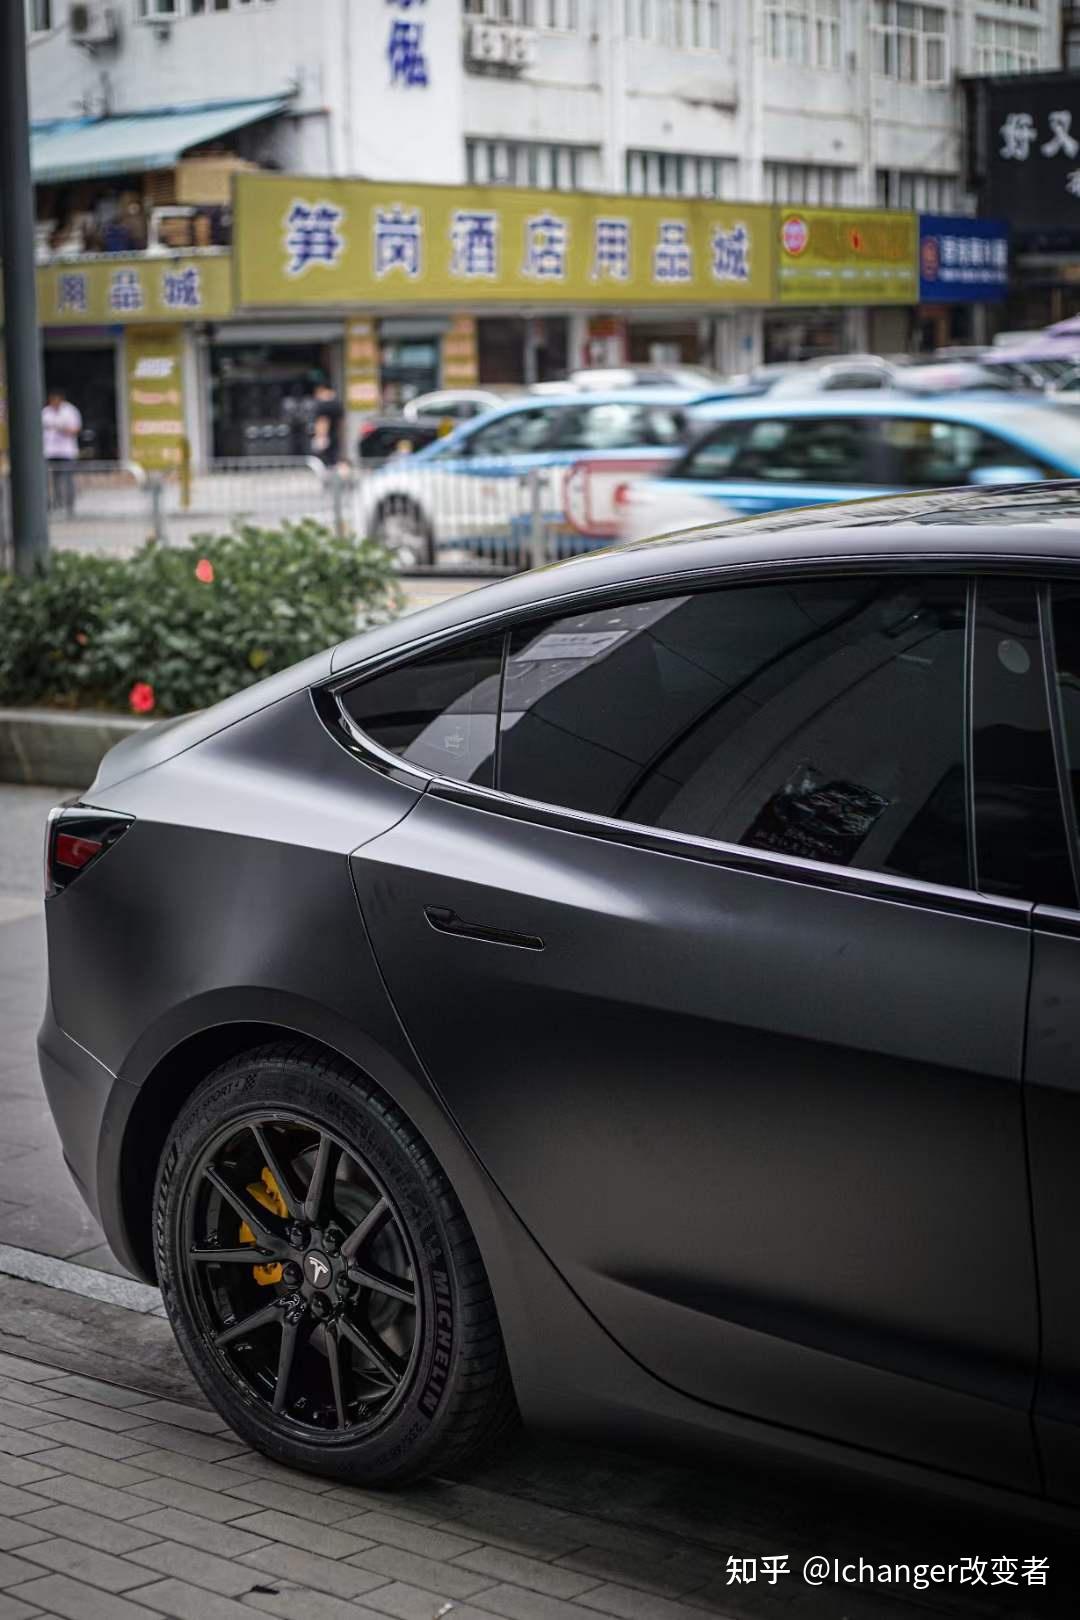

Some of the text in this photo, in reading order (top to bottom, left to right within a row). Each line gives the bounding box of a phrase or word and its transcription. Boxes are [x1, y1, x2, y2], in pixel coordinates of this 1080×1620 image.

[284, 199, 750, 284] 笋岗酒店用品城
[56, 267, 202, 313] 用品城
[421, 1269, 452, 1412] MICHELIN
